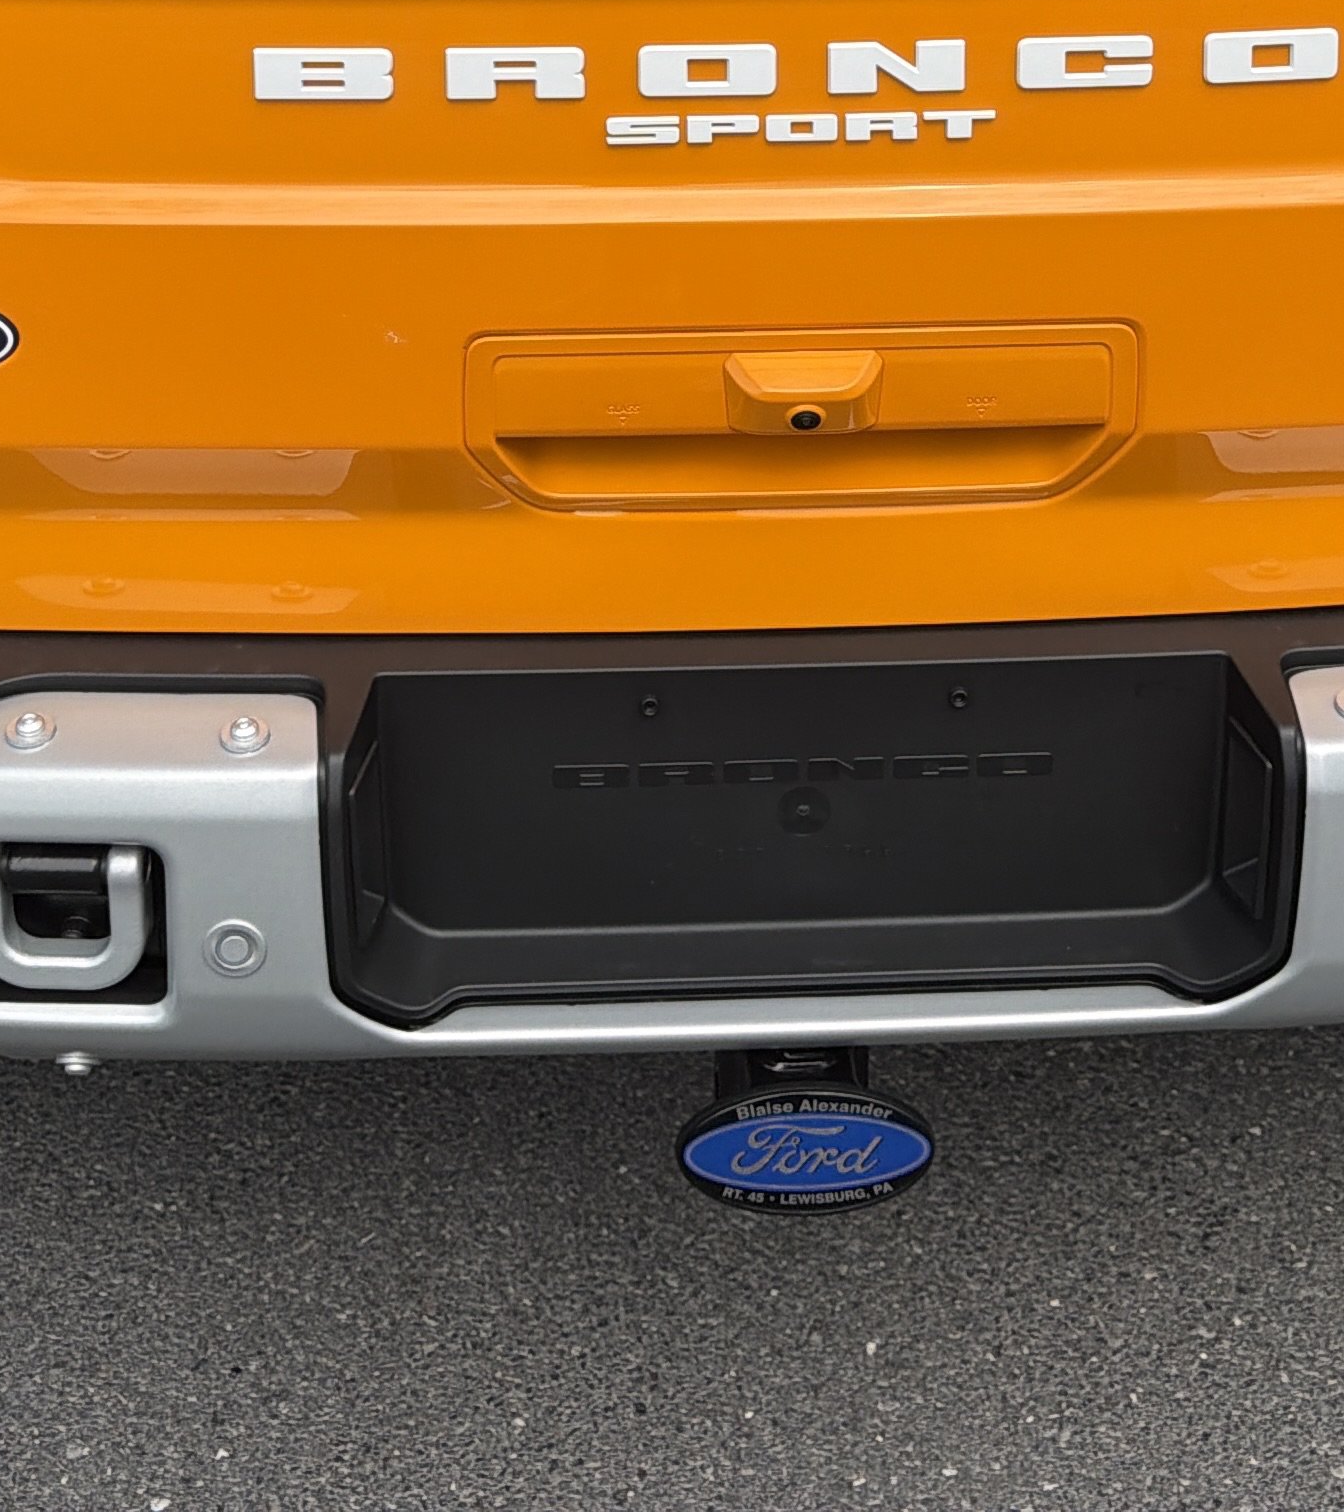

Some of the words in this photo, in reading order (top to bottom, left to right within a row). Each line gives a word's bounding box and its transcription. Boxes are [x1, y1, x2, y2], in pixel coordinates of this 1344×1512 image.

[253, 27, 1340, 101] BRONCO
[605, 109, 996, 146] SPORT
[966, 397, 997, 407] DOOR
[553, 752, 1053, 787] BRONCO
[736, 1100, 794, 1121] Blaise
[799, 1099, 893, 1119] Alexander
[730, 1124, 882, 1175] Ford
[722, 1187, 743, 1201] RT.
[780, 1189, 871, 1205] LEWISBURG,
[874, 1183, 895, 1196] PA
